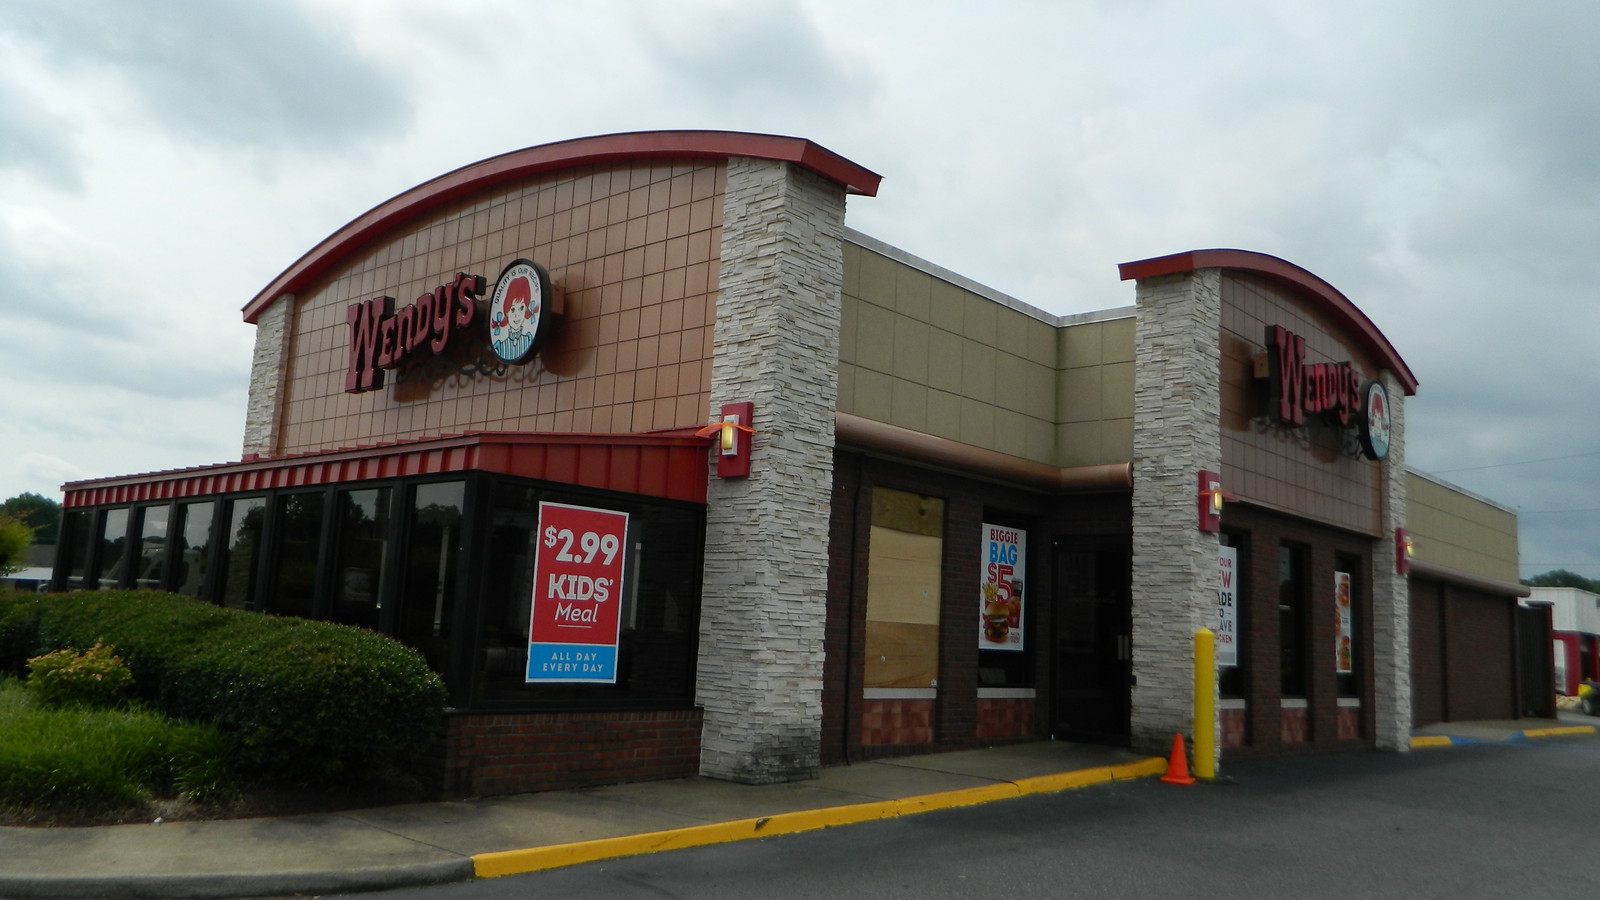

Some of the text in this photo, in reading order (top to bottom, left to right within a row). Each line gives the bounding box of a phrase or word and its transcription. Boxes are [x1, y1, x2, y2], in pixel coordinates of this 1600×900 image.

[494, 275, 510, 304] QUALITY
[511, 269, 517, 277] IS
[543, 525, 620, 566] $2.99
[990, 528, 1019, 544] BIGGIE
[989, 541, 1018, 565] BAG
[547, 573, 614, 602] KIDS'
[987, 562, 1015, 605] $5
[1217, 592, 1232, 607] ADE
[554, 602, 599, 623] Meal
[542, 663, 604, 672] EVERY DAY
[551, 652, 597, 661] ALL DAY
